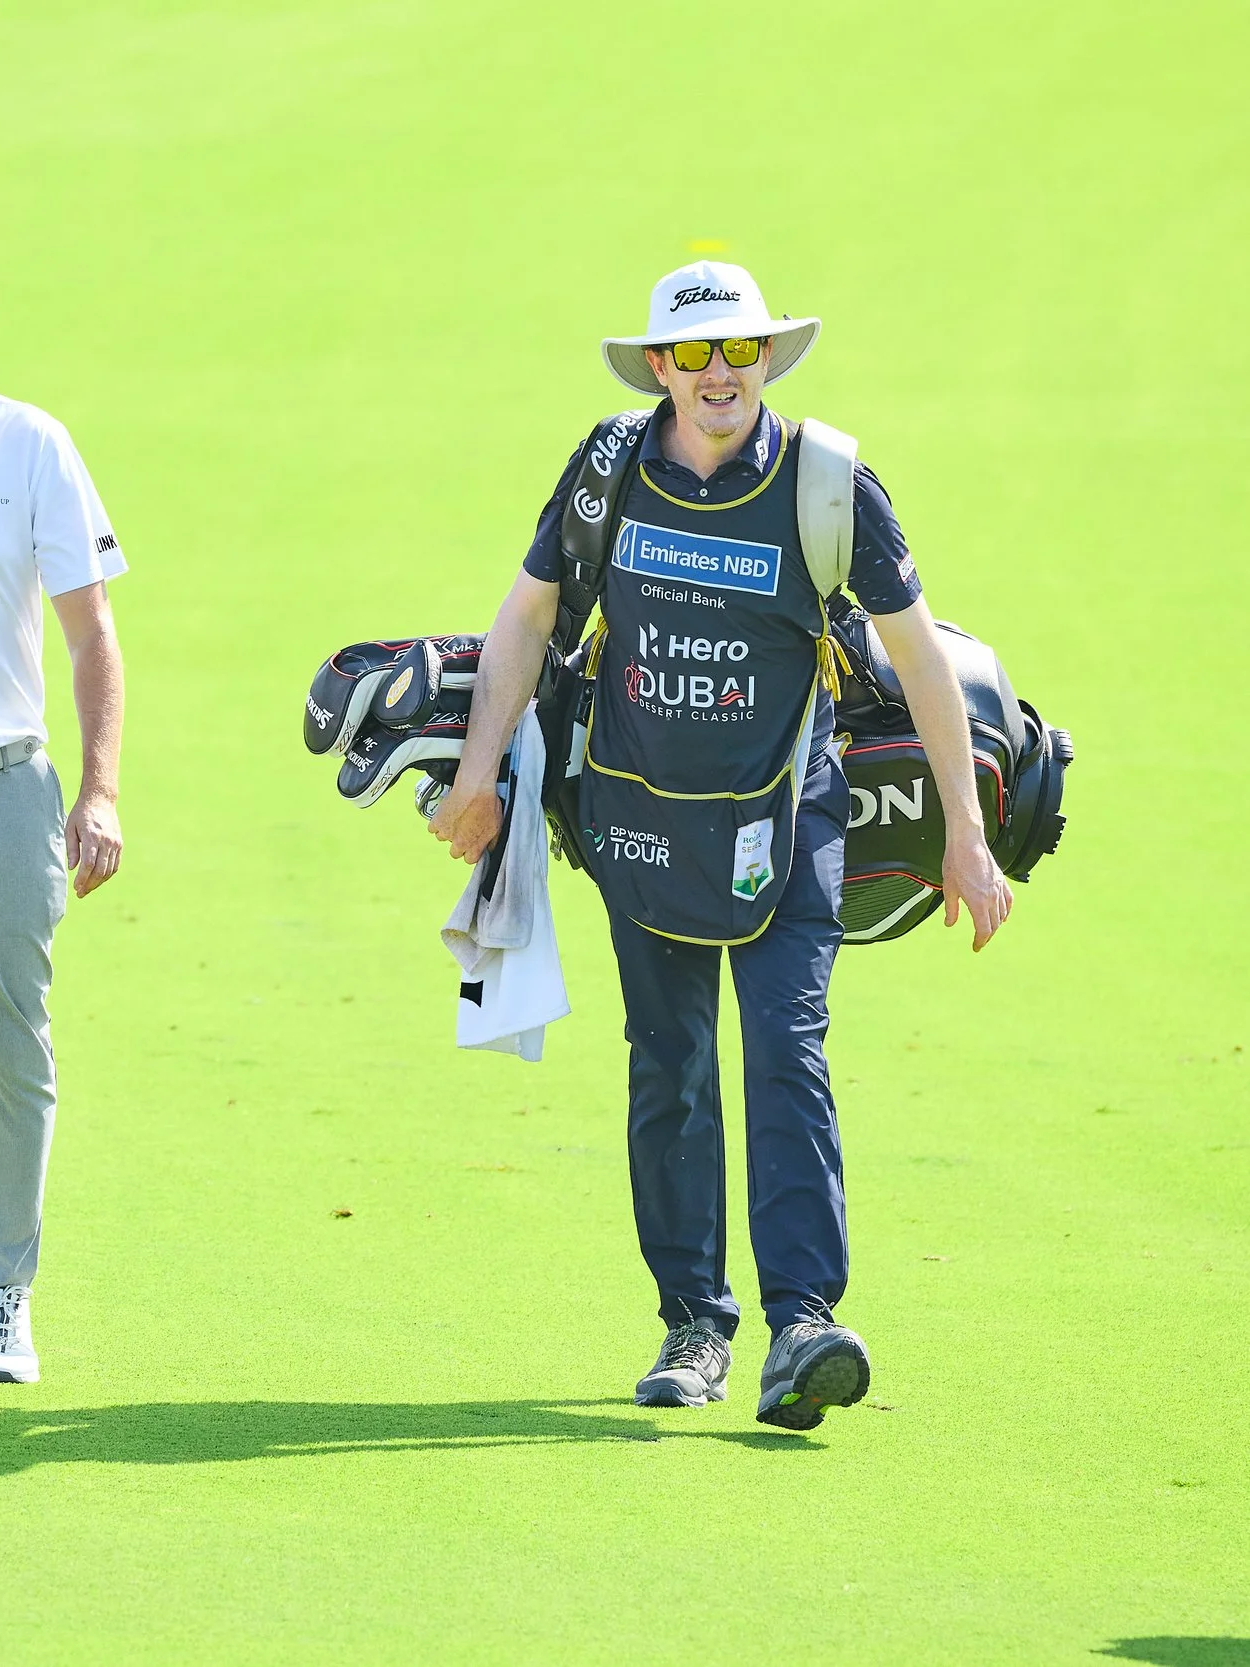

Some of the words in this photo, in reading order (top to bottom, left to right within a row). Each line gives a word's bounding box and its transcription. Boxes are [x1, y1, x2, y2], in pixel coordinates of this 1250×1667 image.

[669, 286, 741, 312] Titleist
[640, 540, 720, 571] Emirates
[723, 554, 769, 578] NBD
[640, 583, 688, 603] Official
[692, 591, 726, 610] Bank
[668, 634, 749, 662] Hero
[637, 664, 755, 708] DUBAI
[307, 693, 335, 730] SRIXO
[638, 697, 683, 719] DESERT
[690, 710, 754, 722] CLASSIC
[610, 825, 627, 837] DP
[626, 829, 670, 847] WORLD
[610, 836, 670, 868] TOUR
